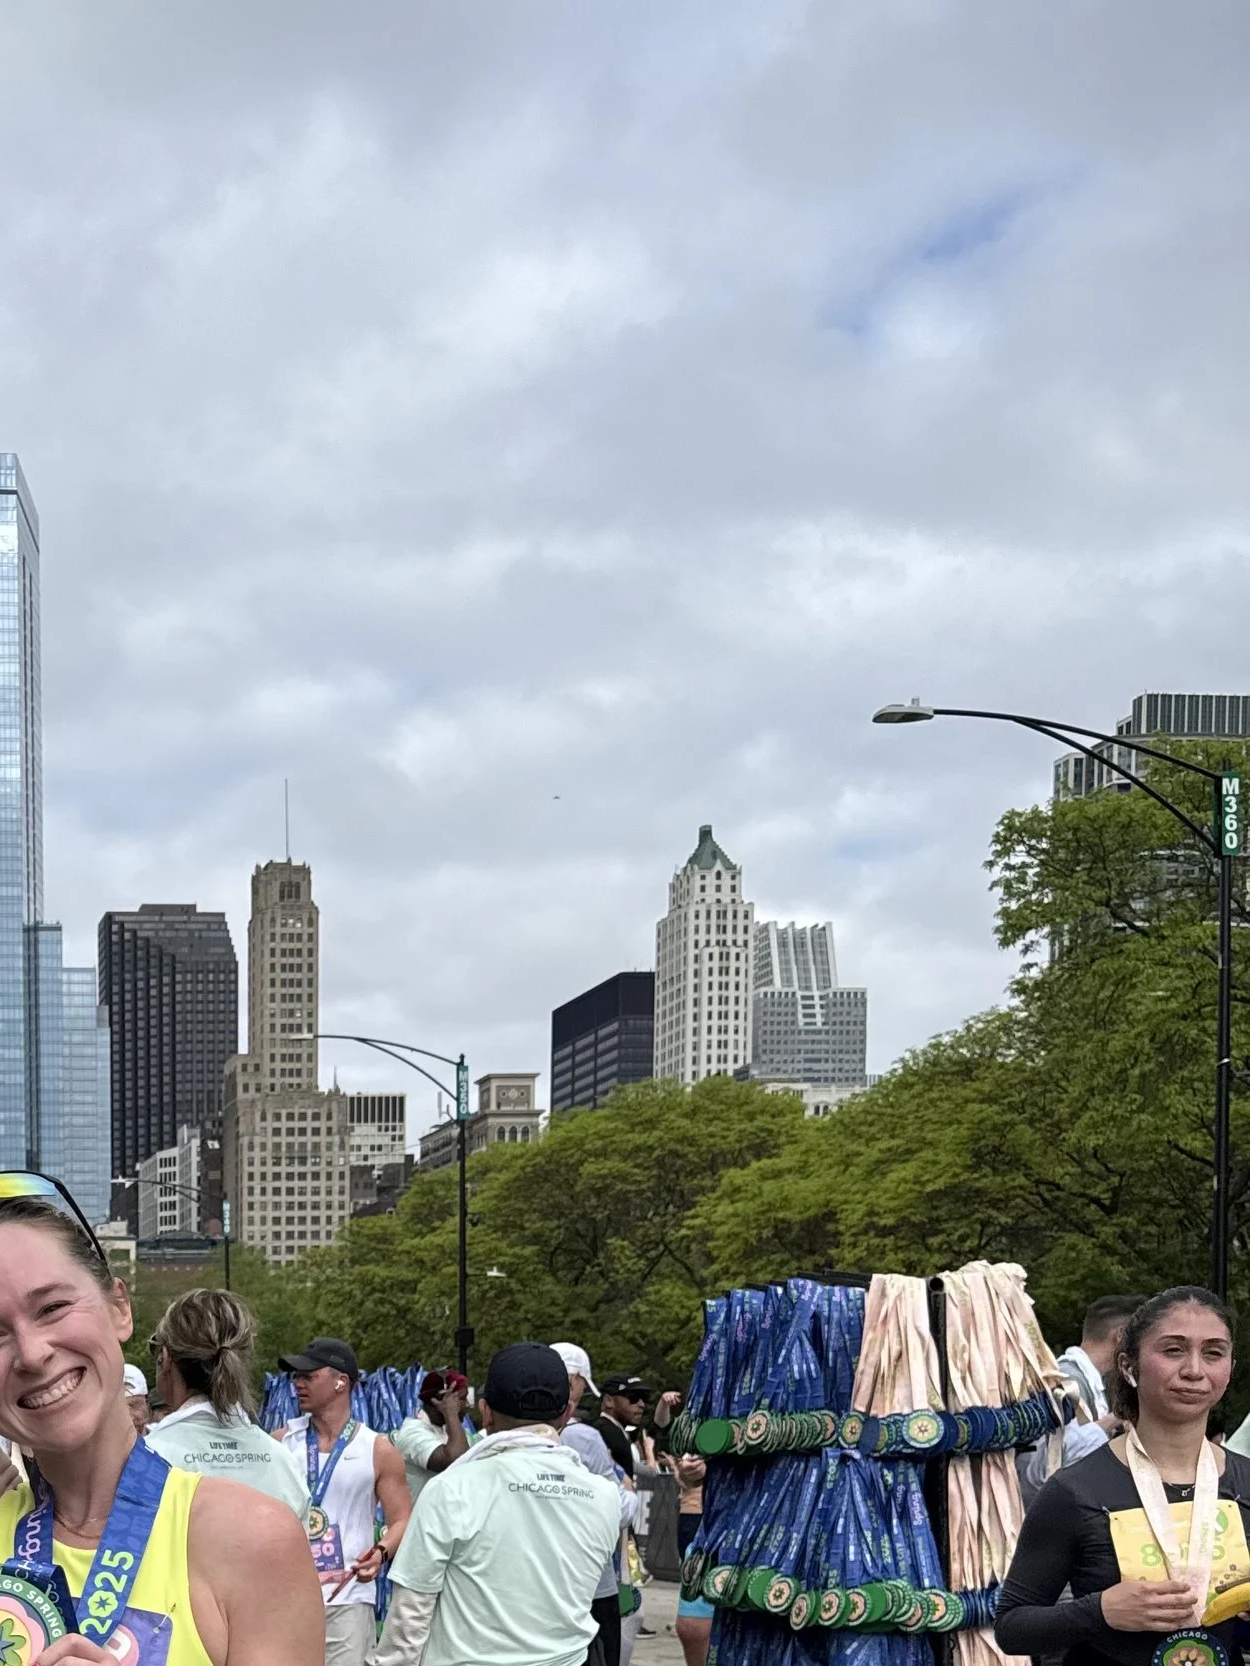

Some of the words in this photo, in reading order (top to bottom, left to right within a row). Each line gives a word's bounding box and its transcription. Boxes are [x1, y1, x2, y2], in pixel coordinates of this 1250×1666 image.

[1222, 777, 1240, 850] M360
[459, 1071, 469, 1114] M350
[184, 1453, 234, 1464] CHICAGO
[235, 1453, 271, 1463] SPRING
[508, 1482, 561, 1494] CHICAGO
[26, 1591, 63, 1638] SPRING
[1166, 1630, 1208, 1643] CHICAGO
